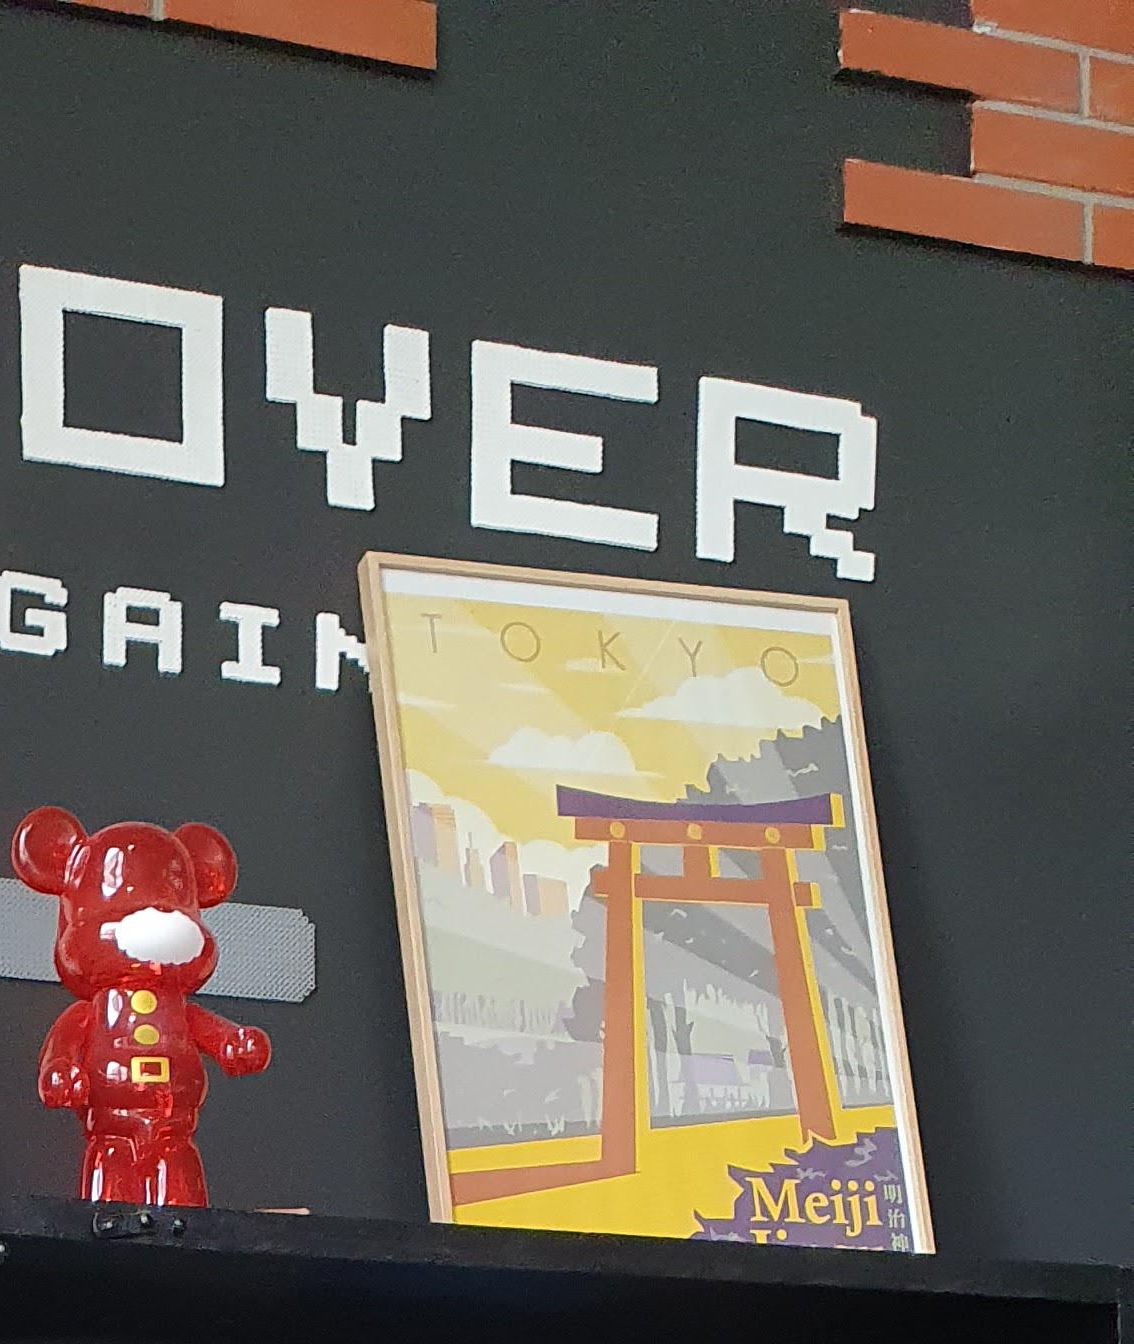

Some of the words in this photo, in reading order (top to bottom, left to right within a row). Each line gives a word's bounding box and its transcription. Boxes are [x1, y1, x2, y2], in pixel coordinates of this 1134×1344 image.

[19, 264, 876, 582] OVER
[420, 611, 799, 689] TOKYO
[746, 1176, 883, 1238] Meiji
